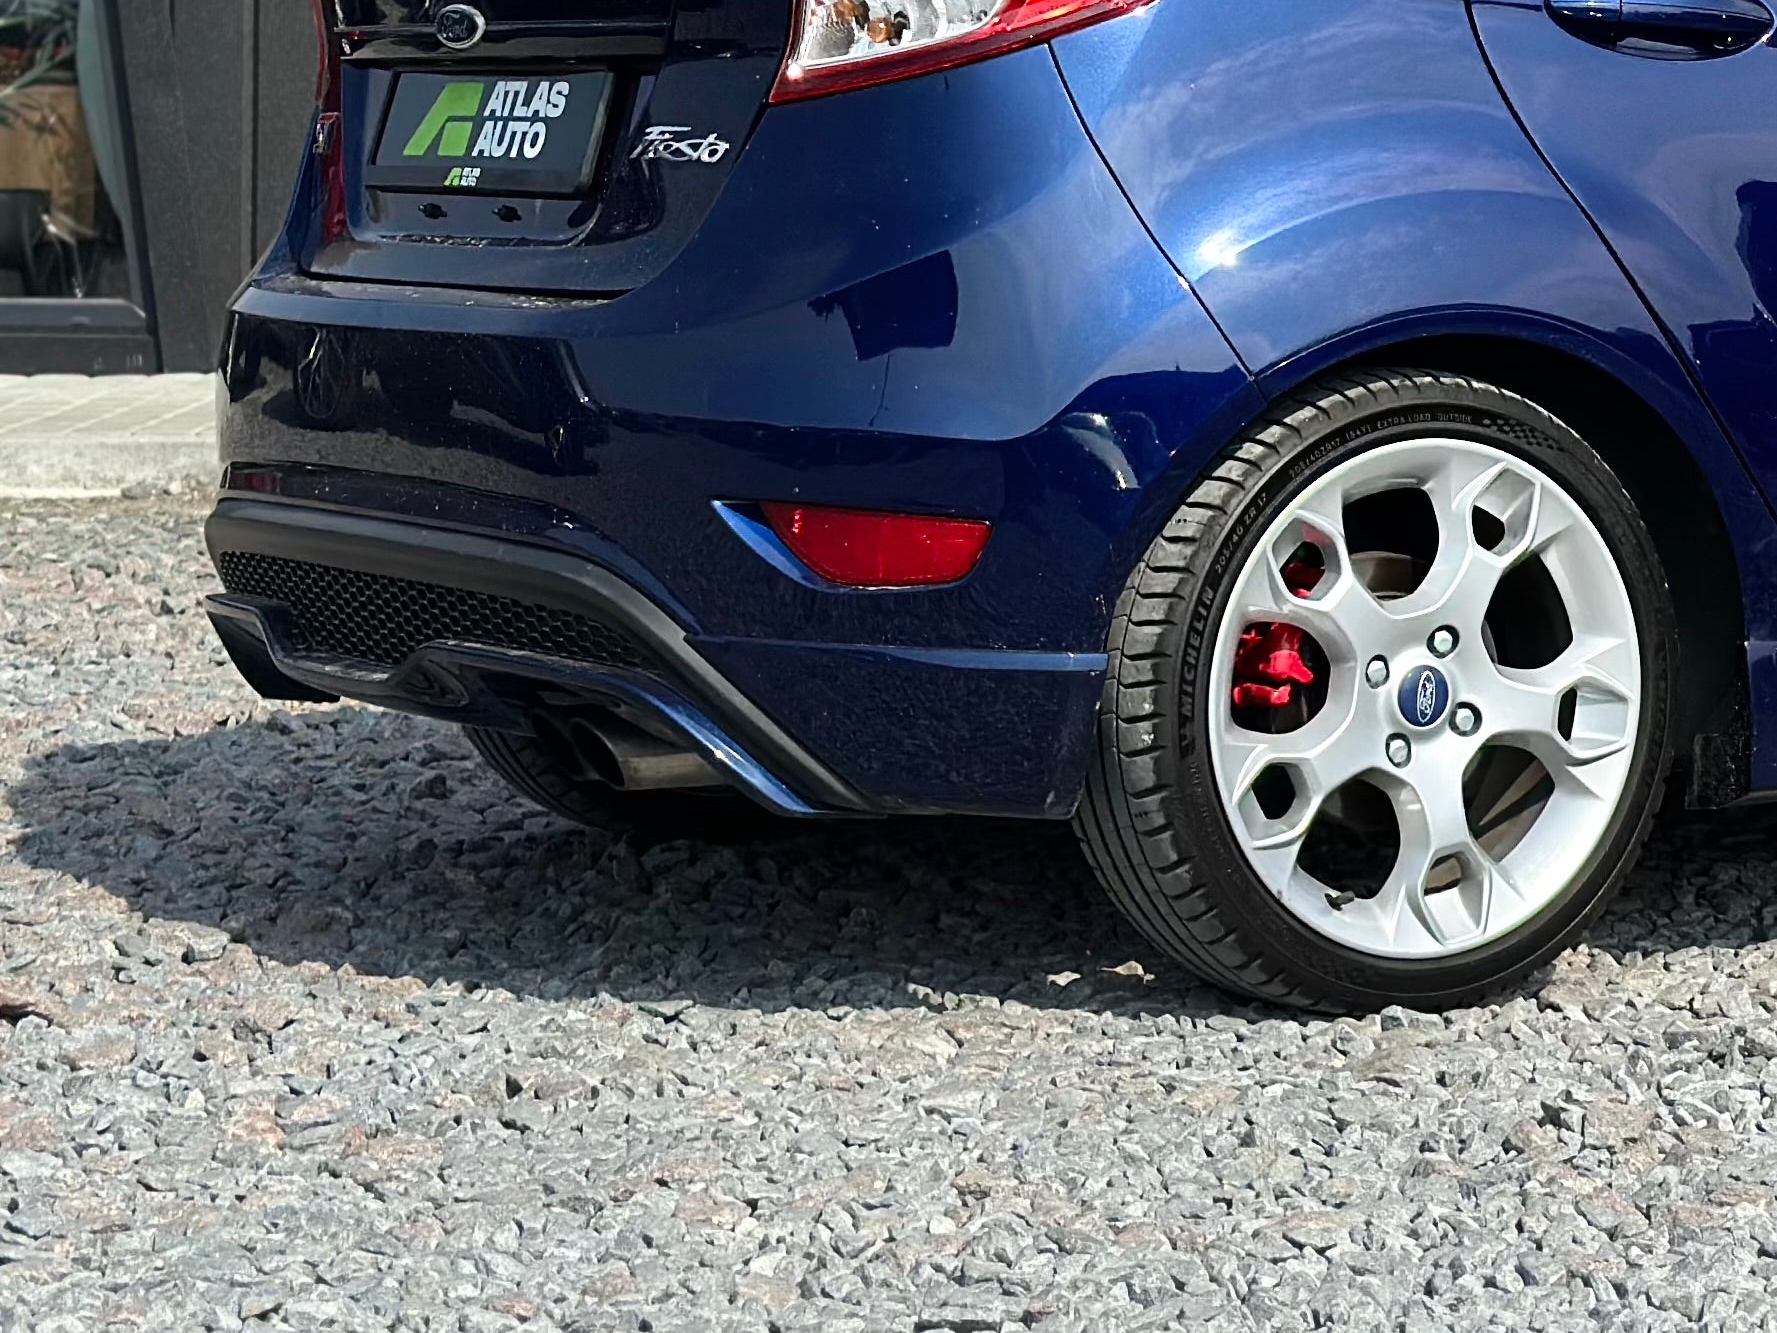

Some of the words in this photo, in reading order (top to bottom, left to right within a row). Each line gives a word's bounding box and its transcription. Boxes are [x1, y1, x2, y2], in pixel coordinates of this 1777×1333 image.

[483, 80, 570, 118] ATLAS
[471, 120, 546, 159] AUTO
[1181, 585, 1214, 717] MICHELIN
